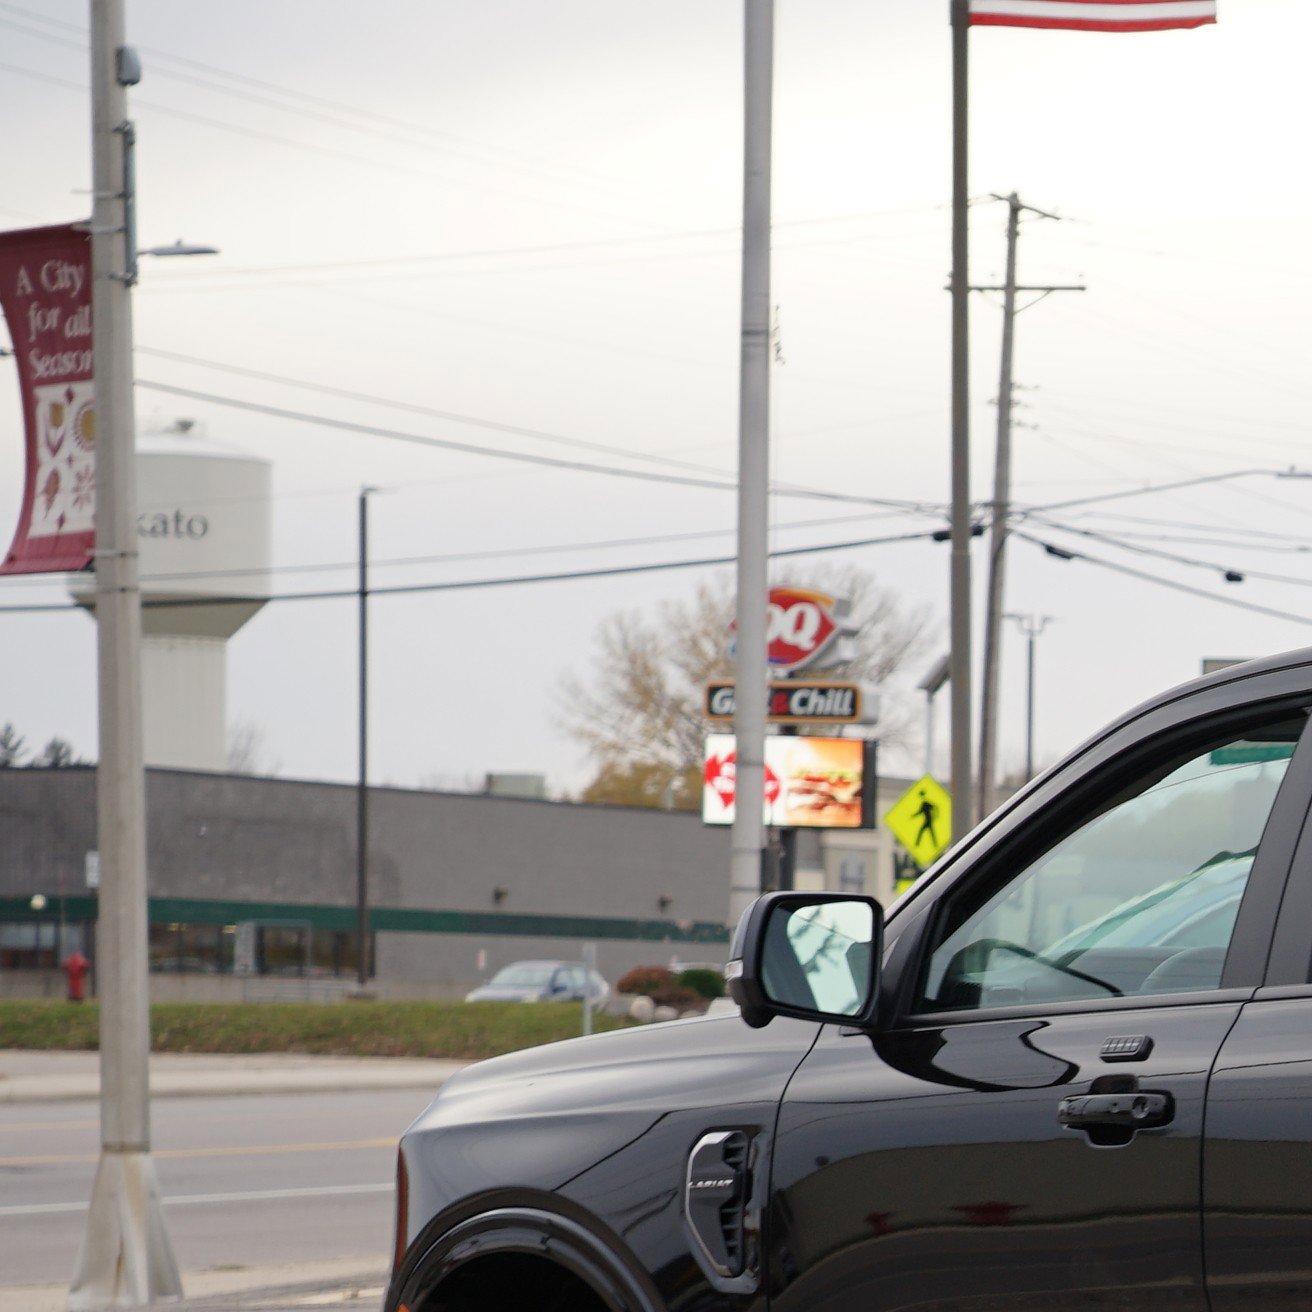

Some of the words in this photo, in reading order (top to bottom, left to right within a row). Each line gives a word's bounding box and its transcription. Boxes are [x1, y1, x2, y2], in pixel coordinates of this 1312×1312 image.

[16, 265, 33, 296] A
[41, 259, 85, 298] City
[29, 301, 61, 343] for
[64, 305, 91, 338] all
[29, 348, 92, 380] Season
[137, 508, 209, 541] kato
[788, 687, 854, 717] Chill
